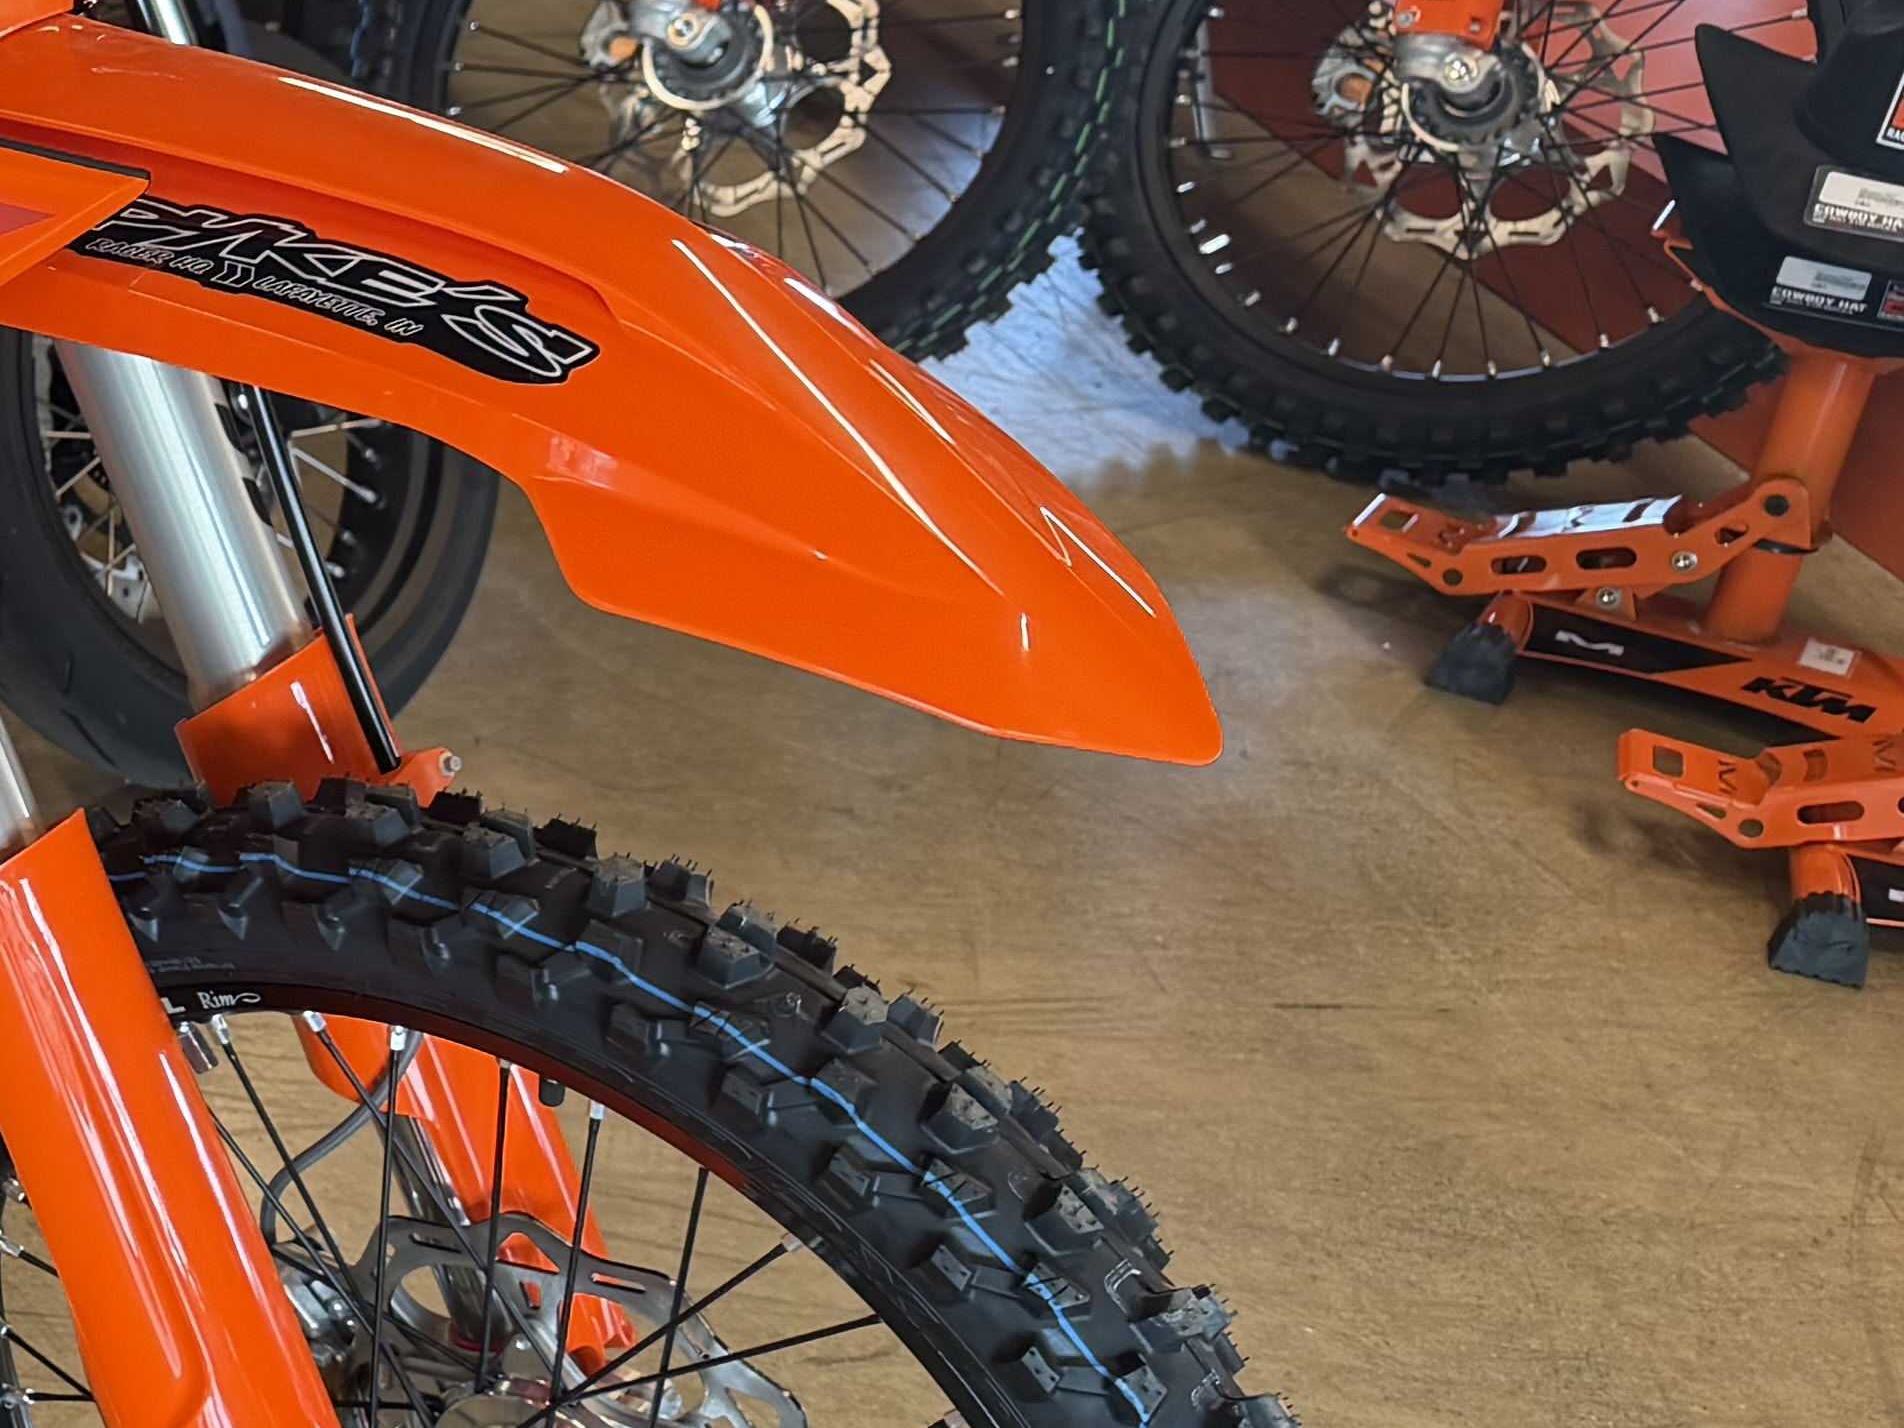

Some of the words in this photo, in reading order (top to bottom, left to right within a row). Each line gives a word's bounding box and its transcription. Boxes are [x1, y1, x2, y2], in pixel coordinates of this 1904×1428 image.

[85, 237, 176, 267] RACER
[252, 274, 387, 327] LAFAYETTE,
[385, 316, 426, 337] IN
[93, 198, 593, 377] PYKE'S
[1739, 675, 1879, 725] KTM
[195, 989, 262, 1010] Rim
